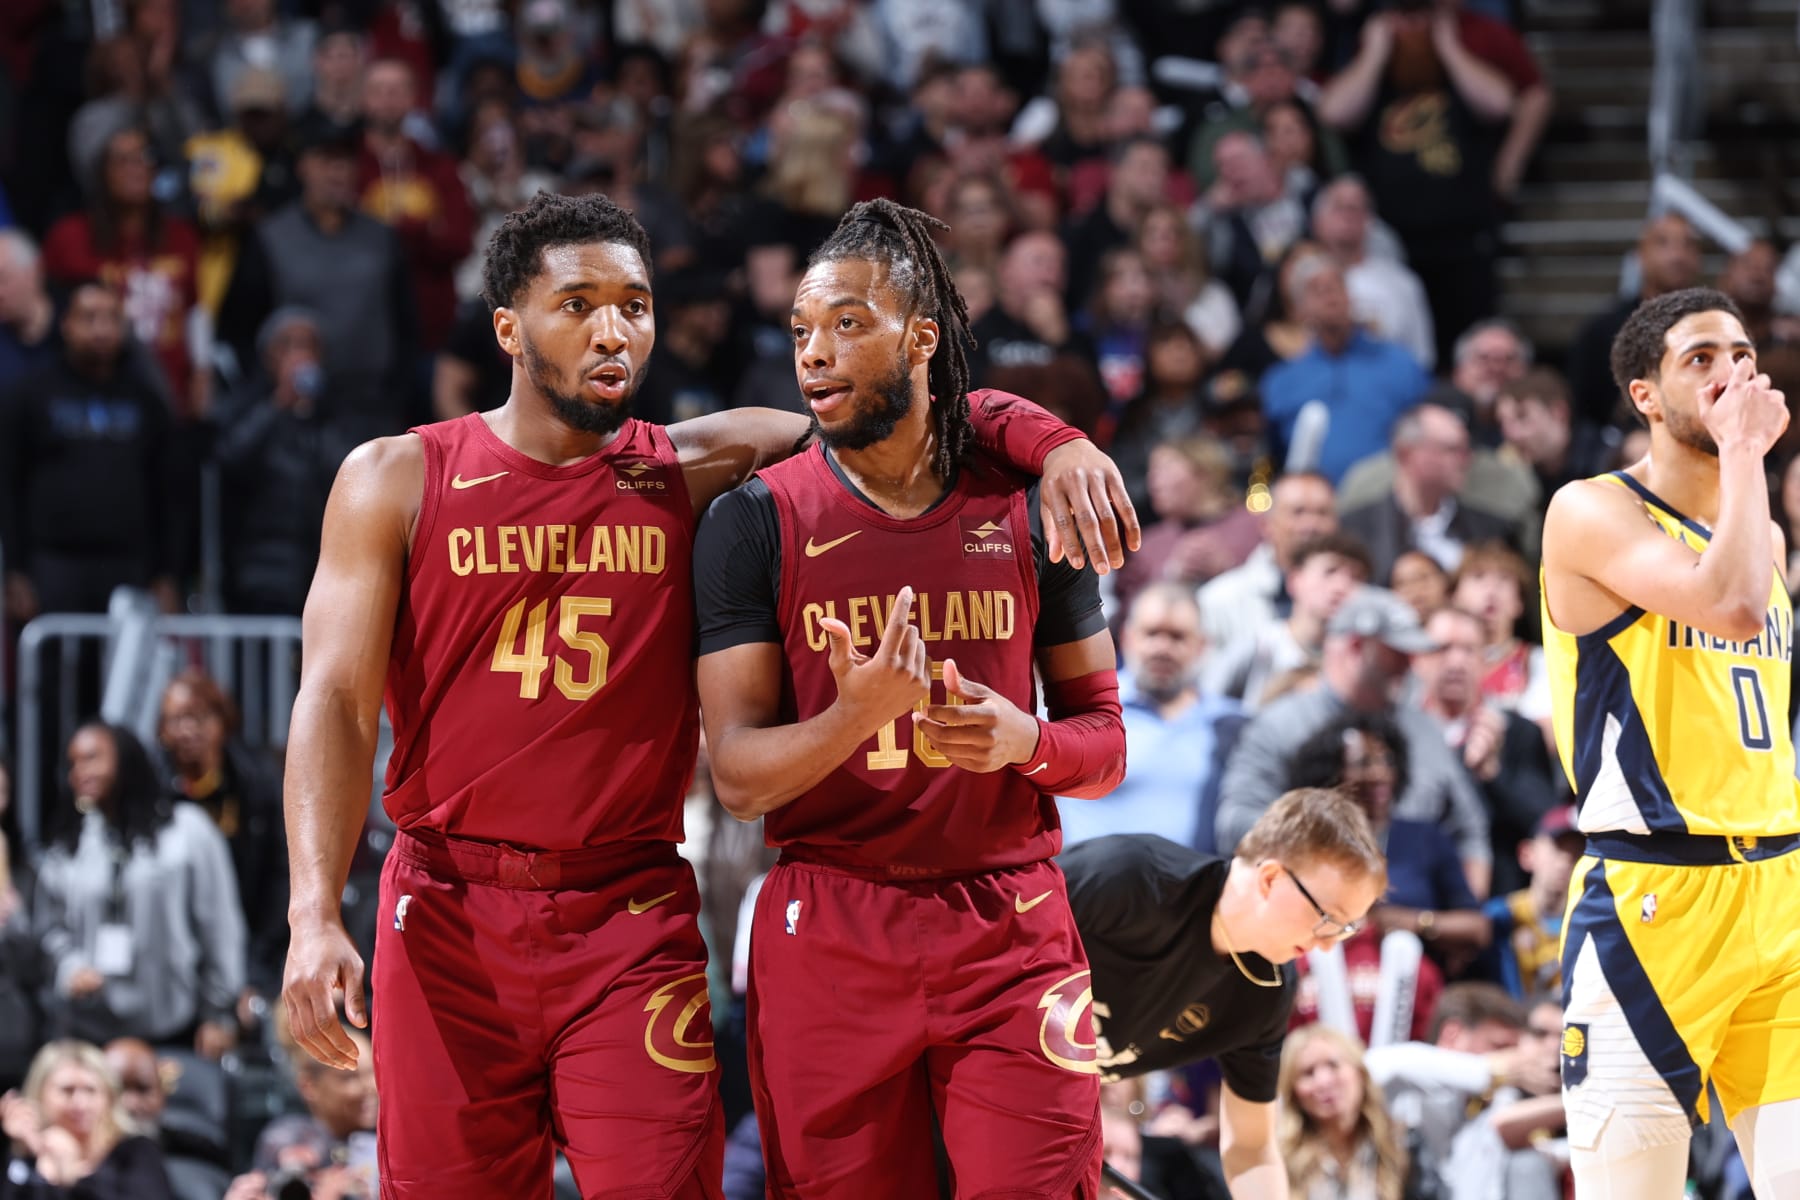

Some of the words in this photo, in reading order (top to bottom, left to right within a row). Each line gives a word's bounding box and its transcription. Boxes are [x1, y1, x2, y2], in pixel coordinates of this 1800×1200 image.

[616, 480, 665, 490] CLIFFS
[447, 525, 666, 577] CLEVELAND
[964, 543, 1012, 553] CLIFFS
[490, 595, 612, 701] 45
[1731, 666, 1772, 752] 0
